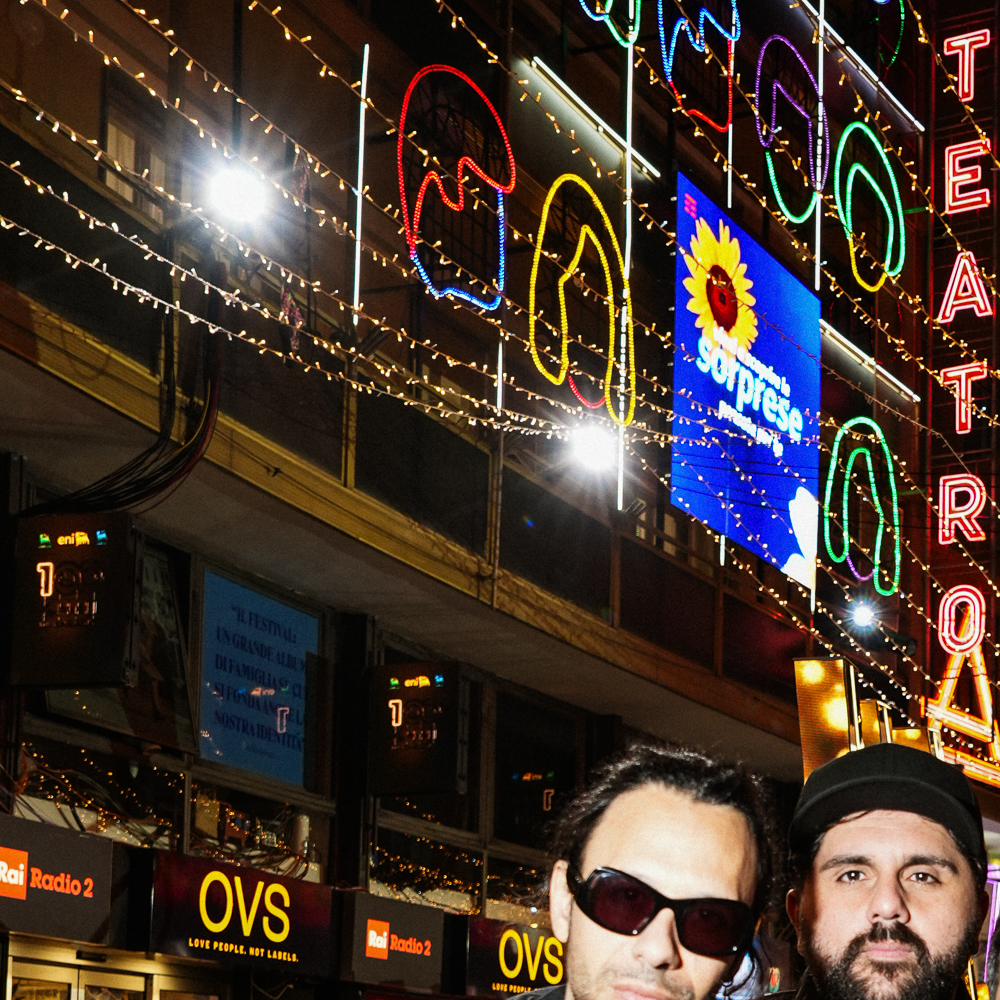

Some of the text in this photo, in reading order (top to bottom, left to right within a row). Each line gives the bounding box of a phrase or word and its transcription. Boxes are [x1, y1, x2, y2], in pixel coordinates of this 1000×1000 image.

[937, 27, 993, 655] TEATRO
[232, 632, 273, 661] GRANDE
[228, 659, 278, 690] FAMIGLIA
[0, 861, 94, 898] Rai Radio 2
[199, 870, 290, 943] OVS
[188, 937, 299, 962] LOVE PEOPLE. NOT LABELS.
[368, 929, 432, 957] Rai Radio 2
[498, 928, 564, 985] OVS
[492, 982, 508, 992] LOVE
